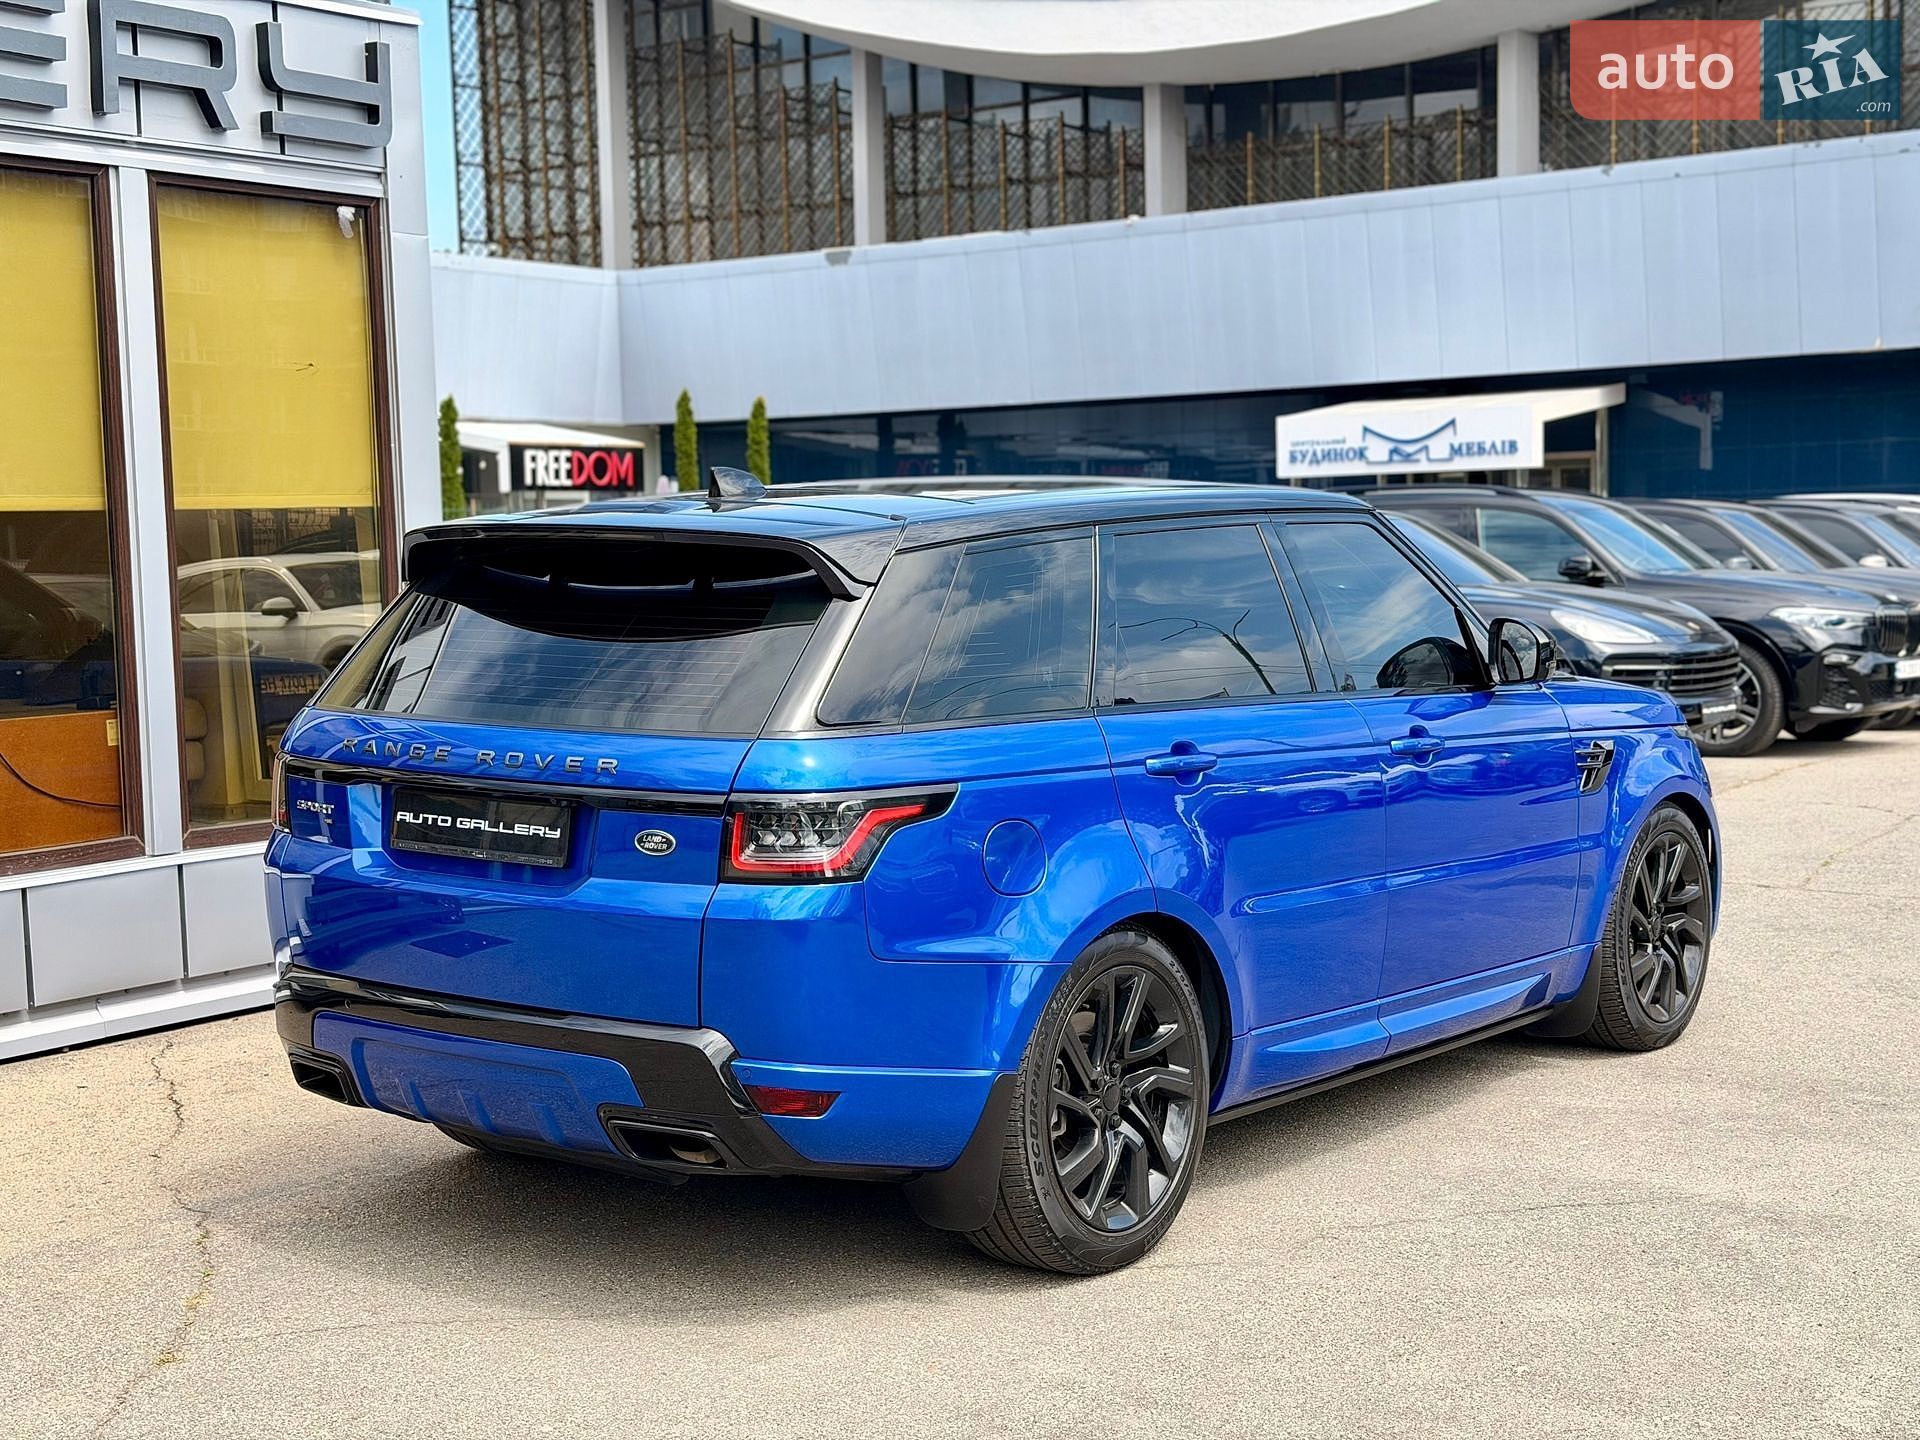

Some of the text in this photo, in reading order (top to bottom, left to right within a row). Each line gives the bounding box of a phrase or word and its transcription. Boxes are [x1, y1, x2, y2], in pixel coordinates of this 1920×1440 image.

[1288, 439, 1519, 466] БУДИНОК МЕБЛІВ
[523, 448, 635, 488] FREEDOM
[341, 736, 619, 775] RANGE ROVER
[296, 799, 334, 814] SPORT
[396, 811, 561, 839] AUTO GALLERY
